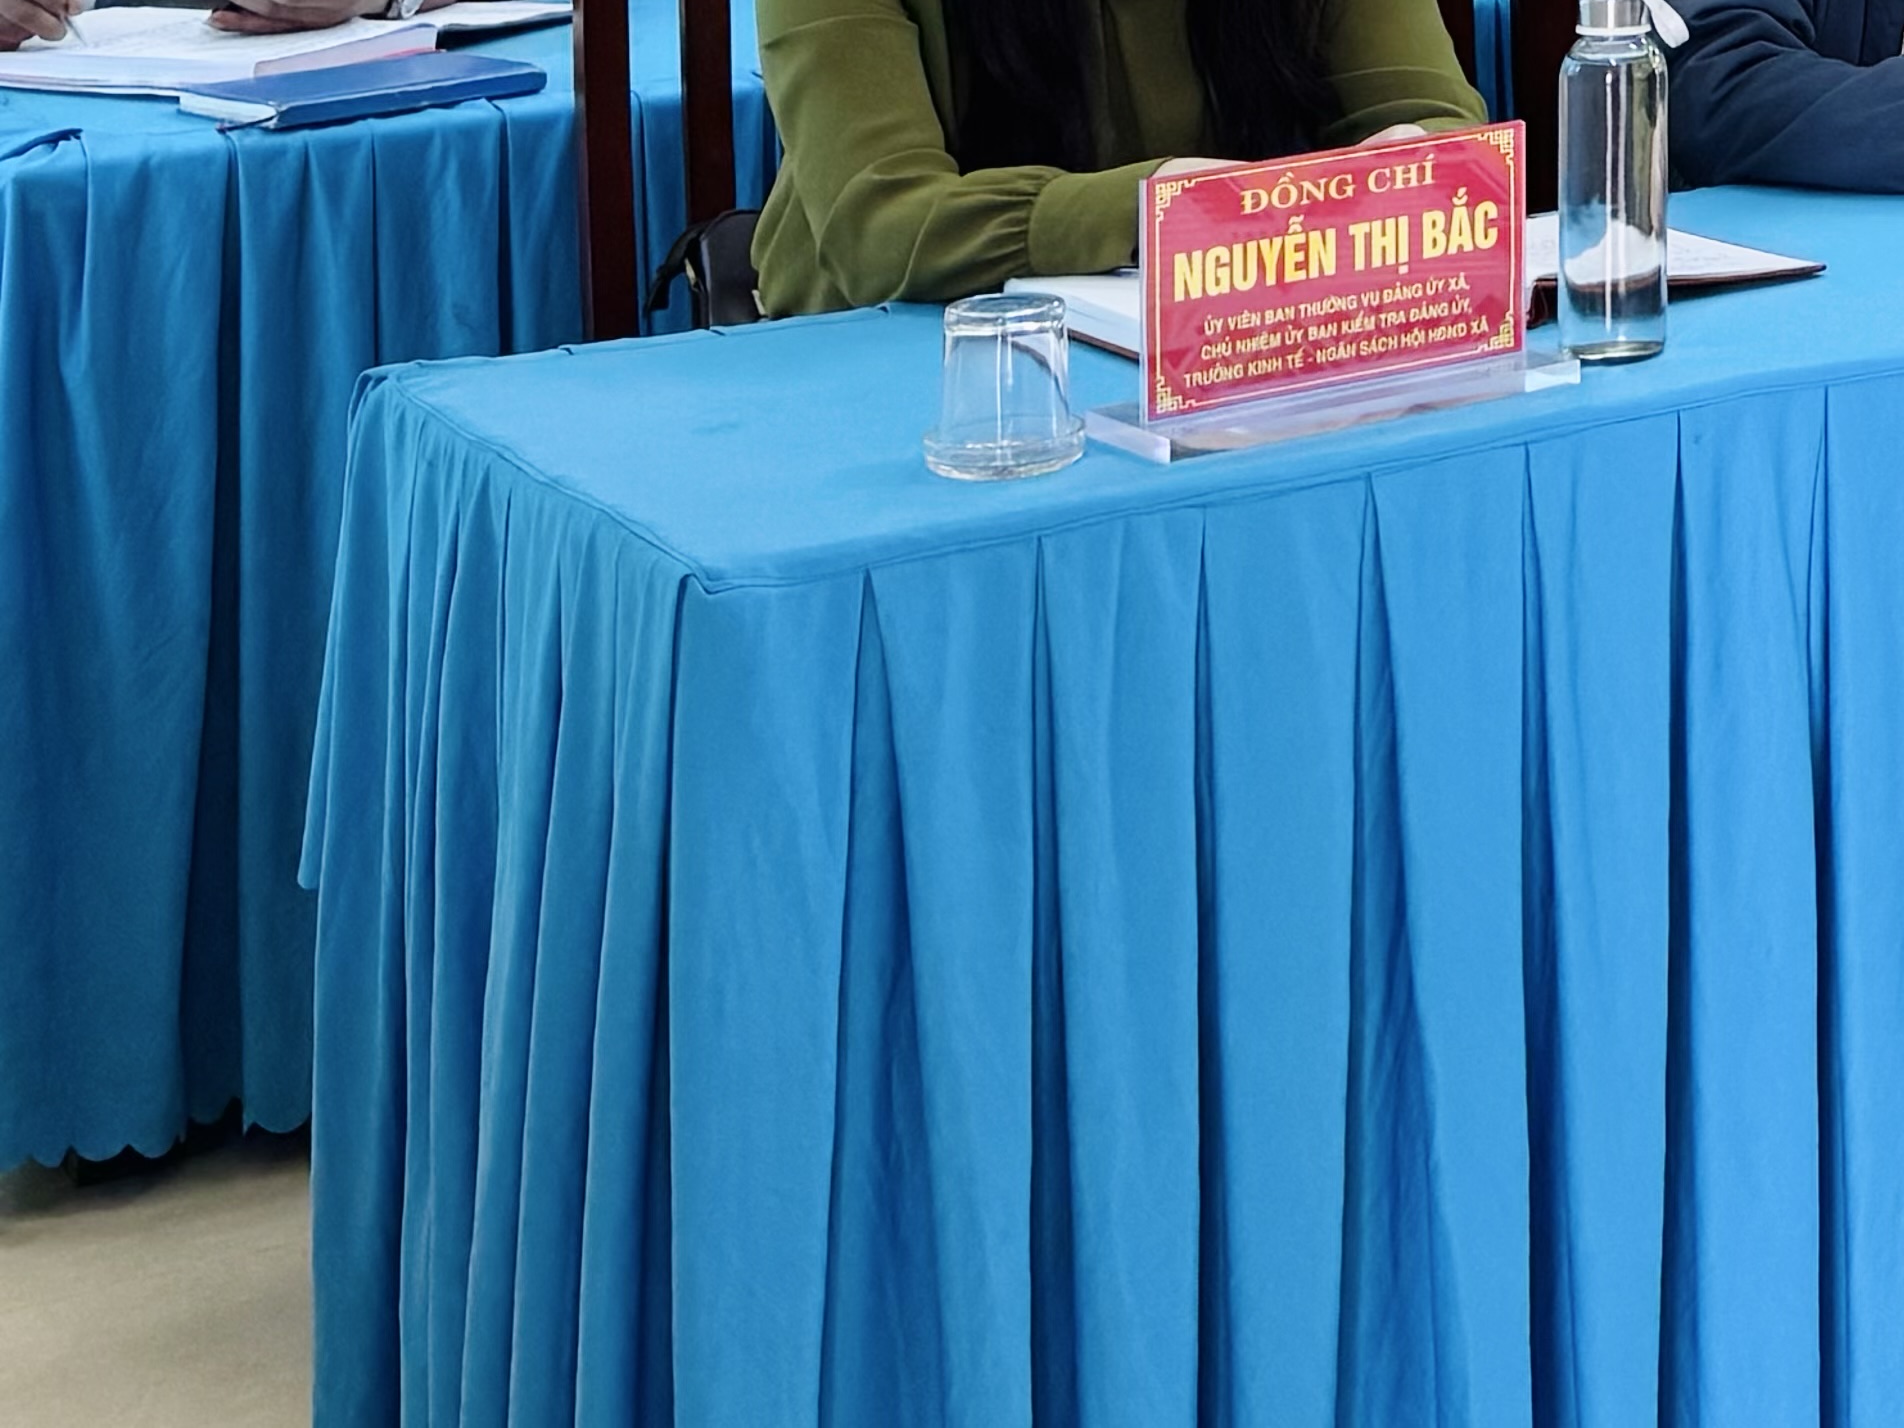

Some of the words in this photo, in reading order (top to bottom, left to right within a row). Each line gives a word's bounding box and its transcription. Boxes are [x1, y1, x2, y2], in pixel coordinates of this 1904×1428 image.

[1240, 171, 1356, 215] ĐỒNG
[1367, 154, 1436, 193] CHÍ
[1173, 214, 1337, 303] NGUYỄN
[1348, 215, 1409, 275] THỊ
[1422, 187, 1499, 259] BẮC
[1228, 306, 1261, 331] VIÊN
[1265, 302, 1295, 325] BAN
[1360, 289, 1381, 310] VỤ
[1308, 322, 1338, 341] BAN
[1379, 311, 1406, 327] TRA
[1183, 362, 1244, 388] TRƯỞNG
[1247, 353, 1282, 377] KINH
[1286, 346, 1305, 369] TẾ
[1359, 333, 1398, 357] SÁCH
